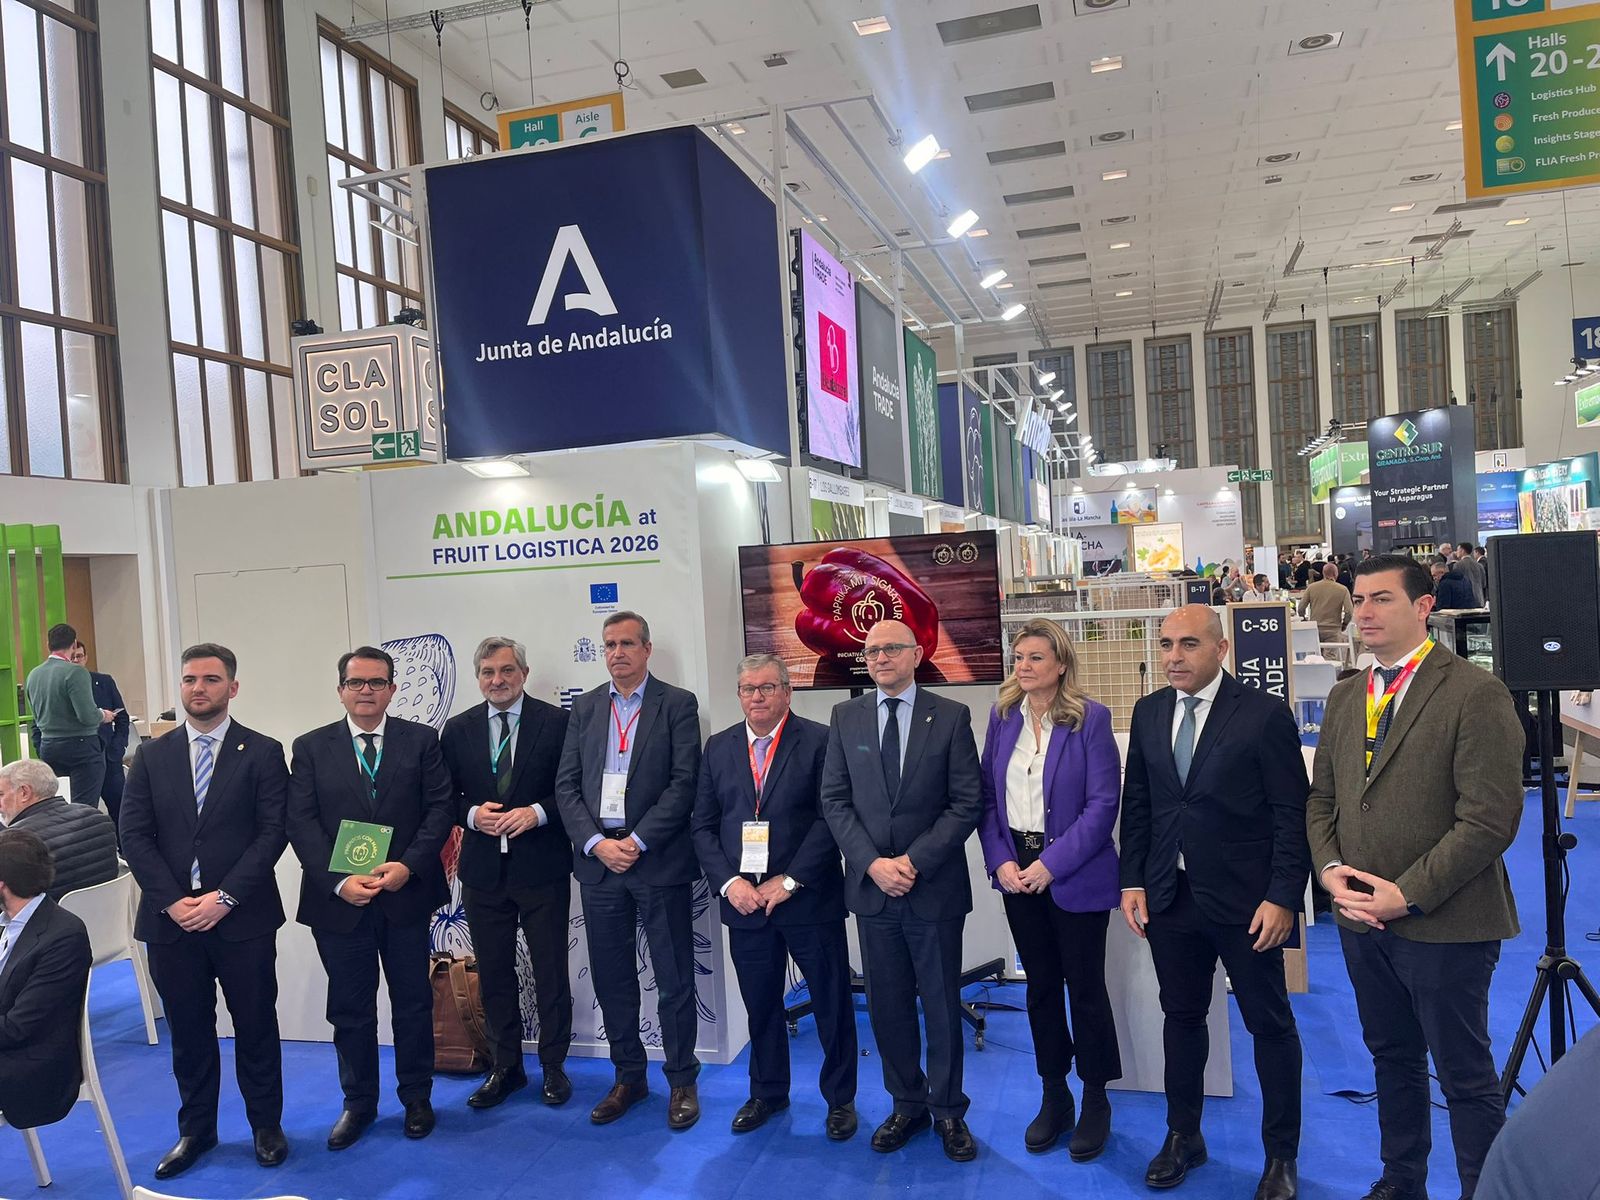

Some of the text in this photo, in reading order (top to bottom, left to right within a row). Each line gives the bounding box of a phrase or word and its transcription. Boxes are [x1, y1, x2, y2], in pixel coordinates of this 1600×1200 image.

[1528, 33, 1567, 49] Halls
[1531, 84, 1597, 101] Logistics Hub
[575, 112, 600, 125] Aisle
[1532, 112, 1560, 123] Fresh
[524, 120, 544, 133] Hall
[1534, 132, 1572, 145] Insights
[1535, 156, 1558, 167] FLIA
[1560, 153, 1587, 164] Fresh
[475, 317, 673, 363] Junta de Andalucía
[316, 358, 387, 393] CLA
[873, 390, 895, 420] TRADE
[319, 399, 390, 434] SOL
[1420, 442, 1443, 454] SUR
[1374, 483, 1449, 497] Your Strategic Partner
[1397, 494, 1433, 503] Asparagus
[432, 493, 657, 540] ANDALUCÍA at
[433, 534, 659, 565] FRUIT LOGISTICA 2026
[1081, 541, 1103, 551] CHA
[832, 575, 903, 622] PAPRIKA MIT SIGNATUR
[1242, 618, 1279, 632] C-36
[1238, 657, 1260, 690] CÍA
[1265, 656, 1285, 701] ADE
